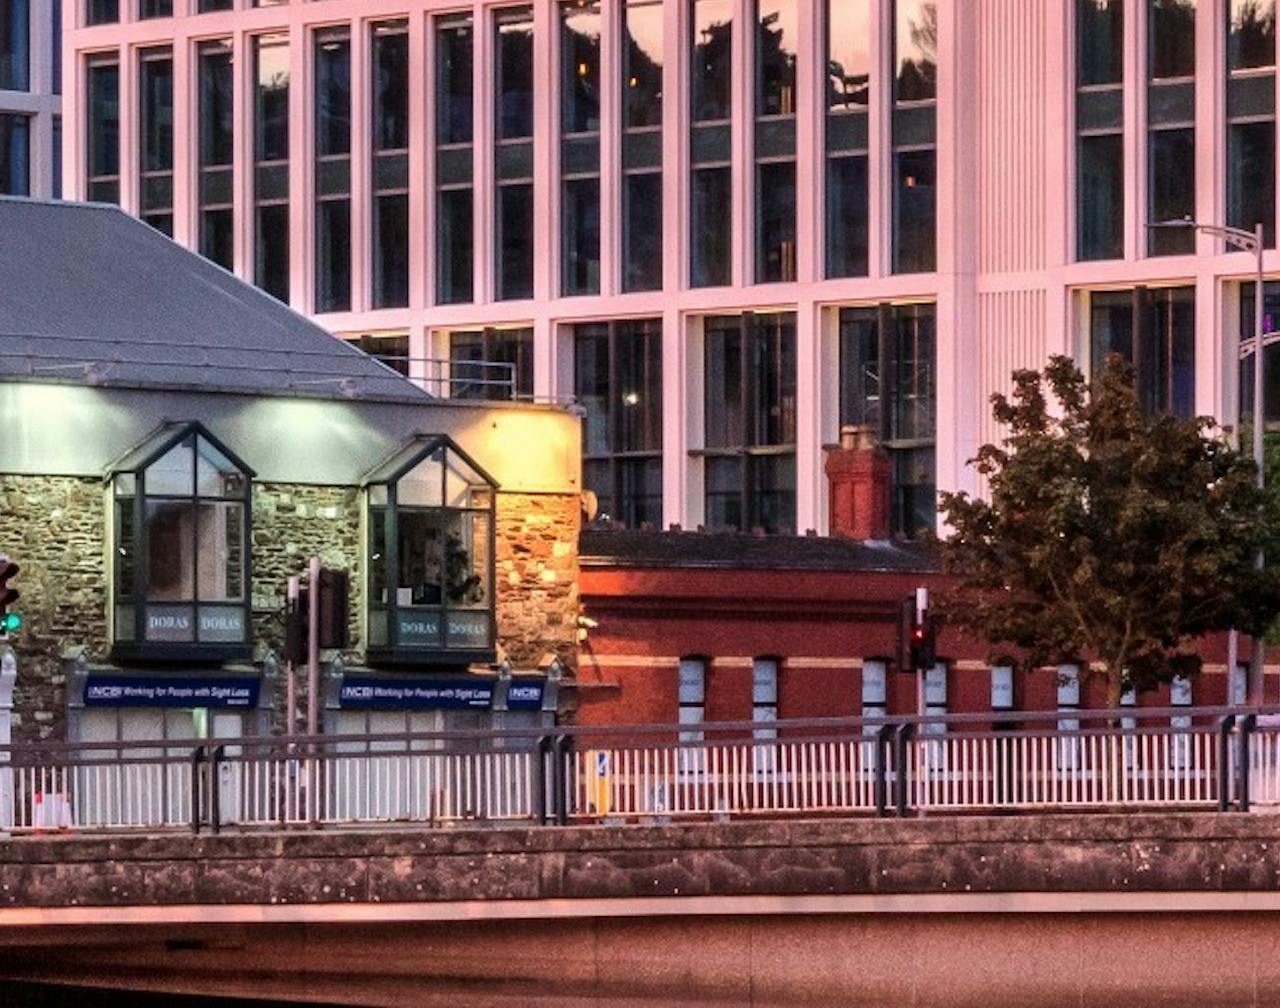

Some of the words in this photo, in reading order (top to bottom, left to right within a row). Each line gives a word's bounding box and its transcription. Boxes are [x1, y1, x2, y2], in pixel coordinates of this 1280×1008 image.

[149, 615, 189, 629] DORAS
[202, 616, 241, 630] DORAS
[400, 622, 437, 634] DORAS
[448, 622, 486, 635] DORAS
[123, 687, 154, 698] Working
[156, 687, 166, 696] for
[168, 687, 194, 698] People
[195, 687, 210, 697] with
[211, 687, 230, 698] Sight
[375, 687, 403, 698] Working
[404, 688, 414, 697] for
[415, 688, 439, 698] People
[439, 689, 454, 698] with
[455, 689, 472, 700] Sight
